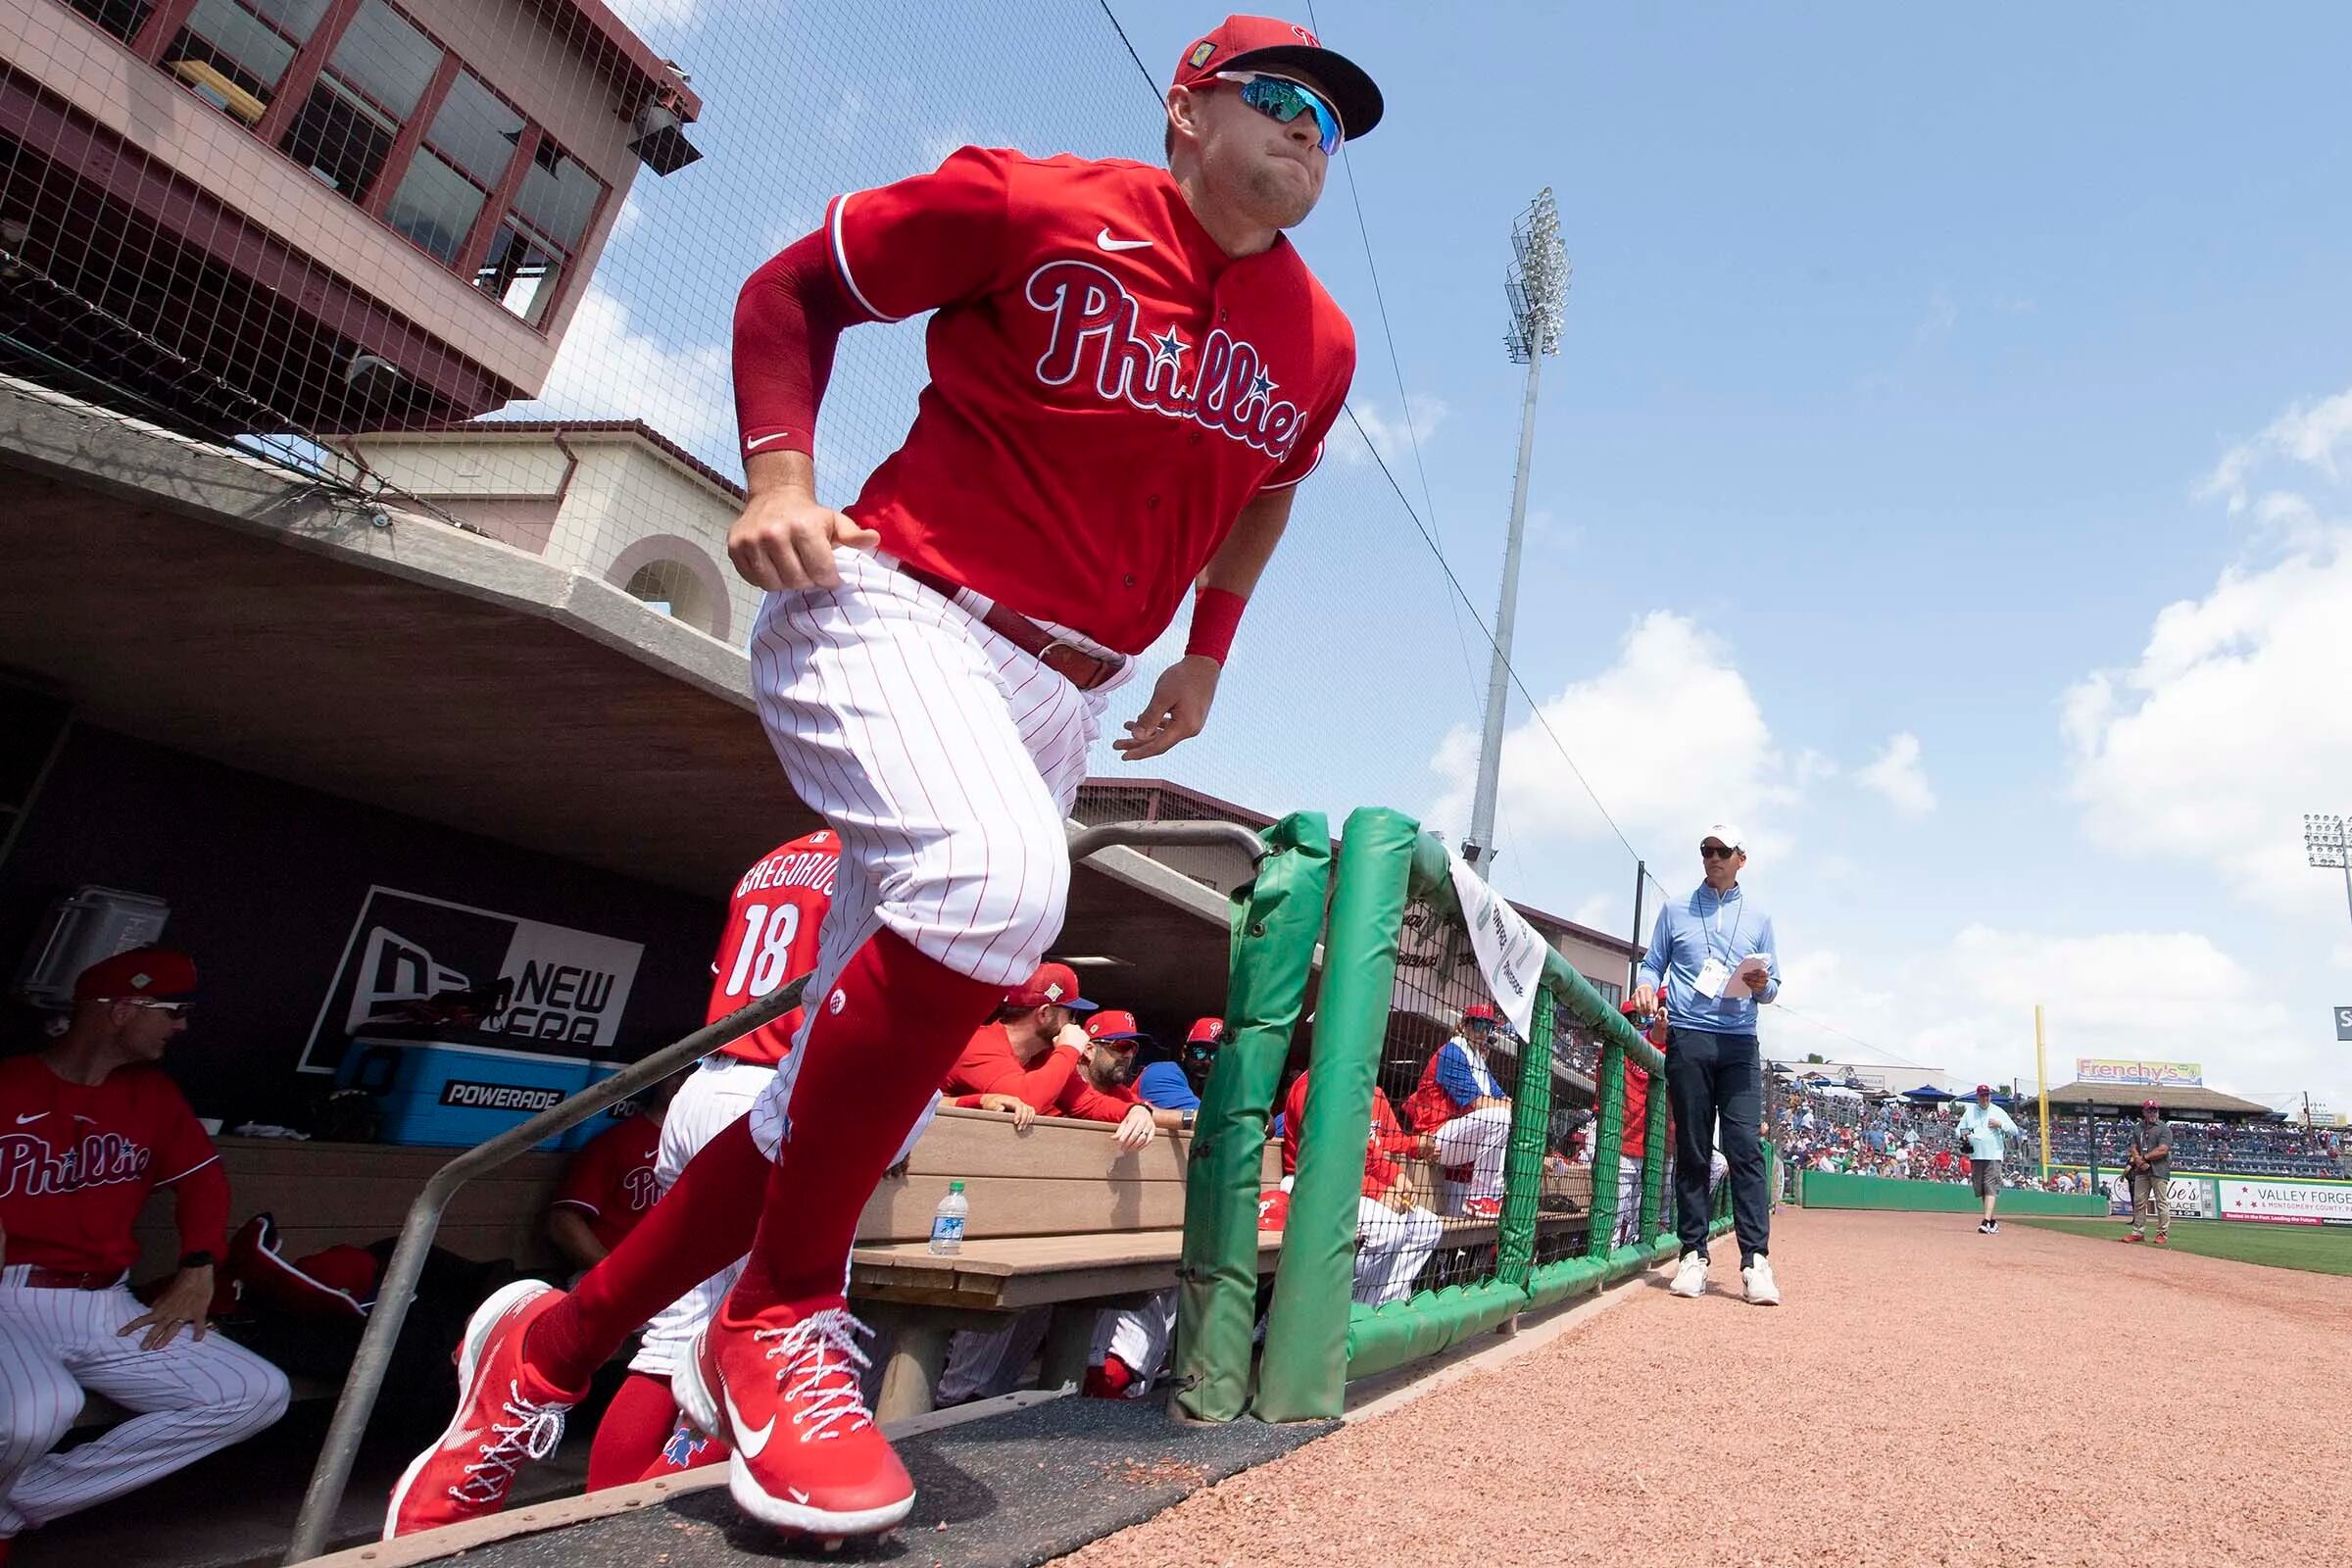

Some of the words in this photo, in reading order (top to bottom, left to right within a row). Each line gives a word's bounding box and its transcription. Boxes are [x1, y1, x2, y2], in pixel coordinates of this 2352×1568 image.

[725, 903, 799, 997] 18
[514, 959, 615, 1014] NEW
[2079, 1058, 2179, 1082] Frenchy's
[447, 1083, 560, 1110] POWERADE
[0, 1133, 151, 1199] Phillie
[2167, 1181, 2199, 1200] be's
[2258, 1189, 2307, 1201] VALLEY
[2311, 1191, 2352, 1203] FORGE
[2168, 1201, 2196, 1210] LACE
